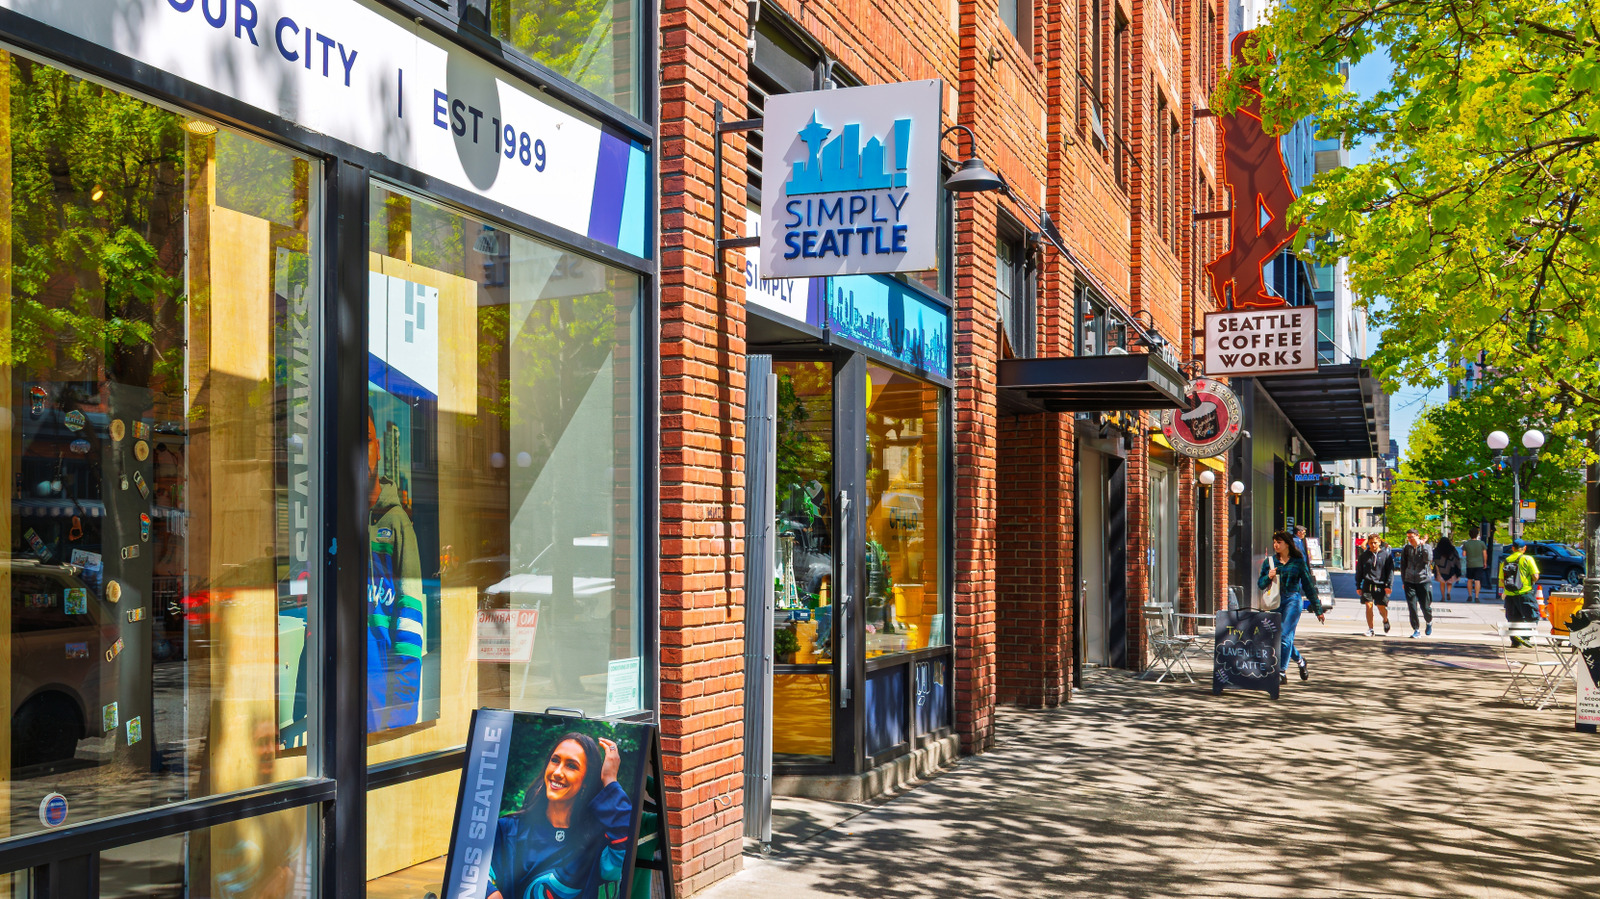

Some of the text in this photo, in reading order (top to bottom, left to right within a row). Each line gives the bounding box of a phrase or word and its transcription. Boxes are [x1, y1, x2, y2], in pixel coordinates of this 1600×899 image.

[275, 17, 358, 88] CITY
[433, 89, 482, 144] EST
[492, 117, 547, 173] 1989
[785, 192, 909, 228] SIMPLY
[784, 224, 908, 259] SEATTLE
[1218, 313, 1301, 332] SEATTLE
[1218, 331, 1301, 350] COFFEE
[1219, 350, 1301, 368] WORKS
[1209, 383, 1239, 423] ESPRESSO
[1170, 435, 1234, 455] ICE CREAMERY
[1226, 625, 1261, 640] Try A
[1236, 661, 1266, 671] LATTE
[469, 726, 503, 840] SEATTLE
